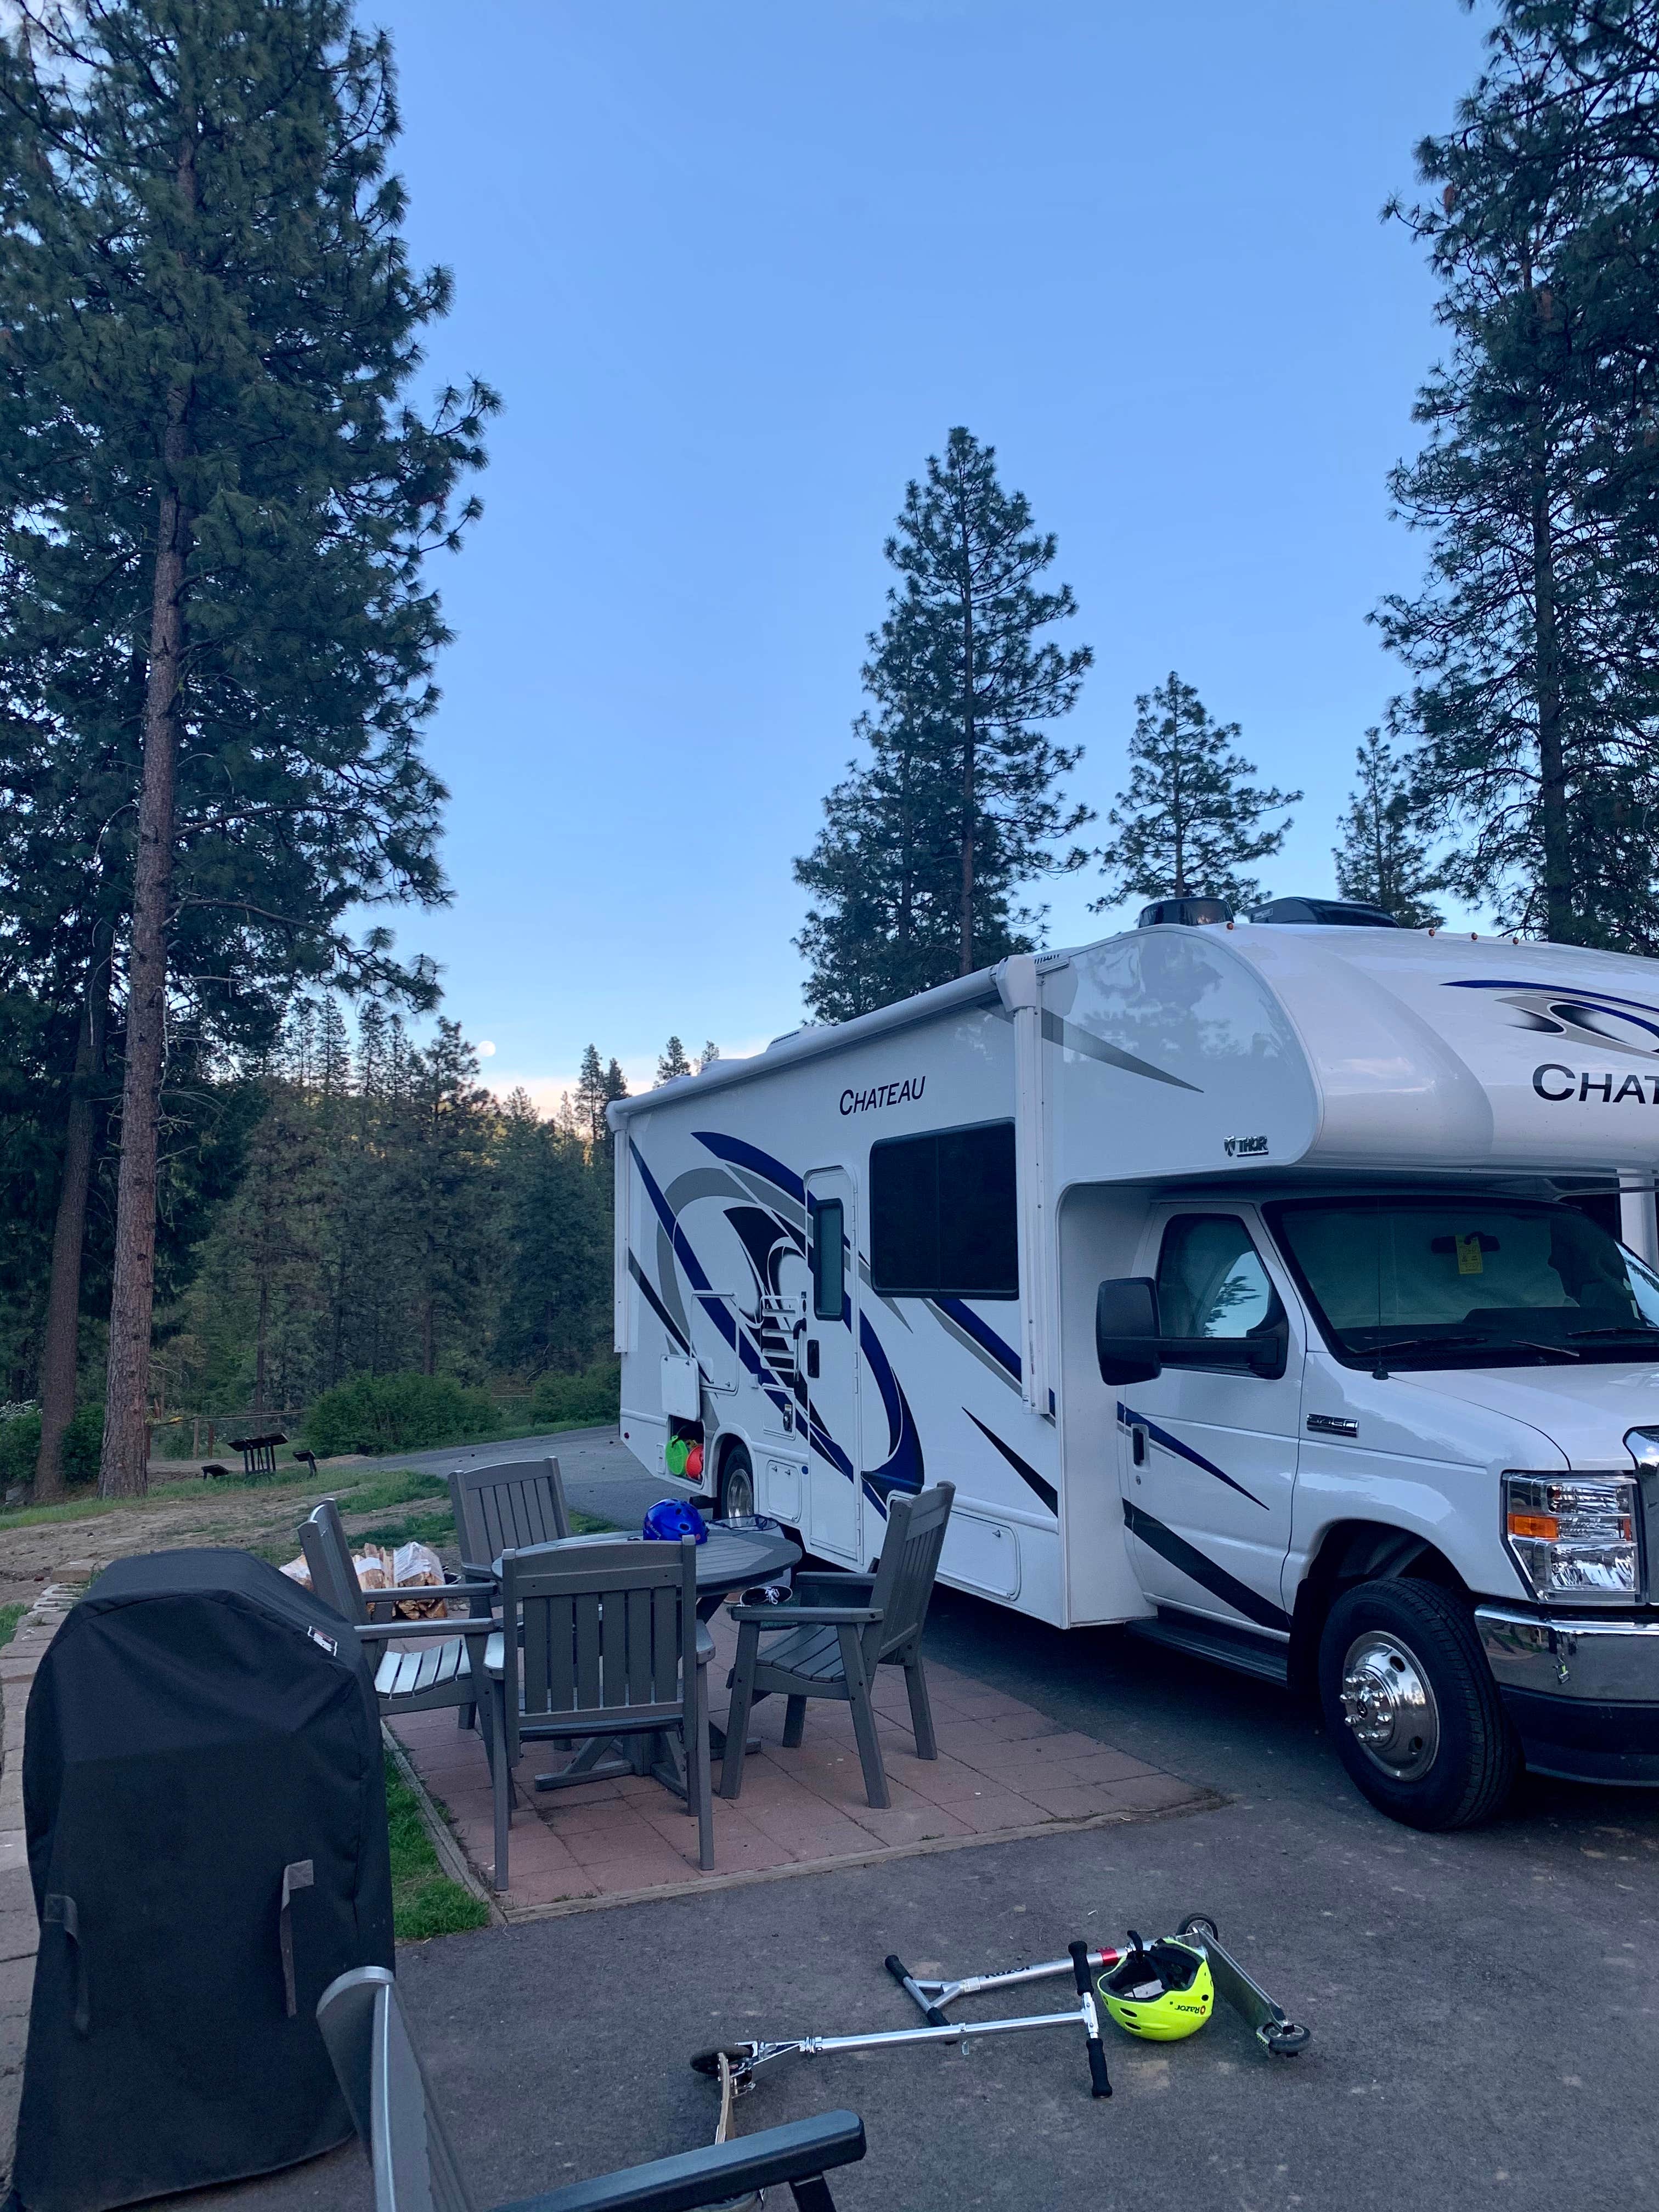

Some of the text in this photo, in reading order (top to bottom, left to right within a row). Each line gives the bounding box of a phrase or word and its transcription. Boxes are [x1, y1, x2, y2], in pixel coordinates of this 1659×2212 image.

[839, 1076, 926, 1115] CHATEAU
[1235, 1136, 1268, 1153] THOR
[1174, 2005, 1200, 2014] Razor
